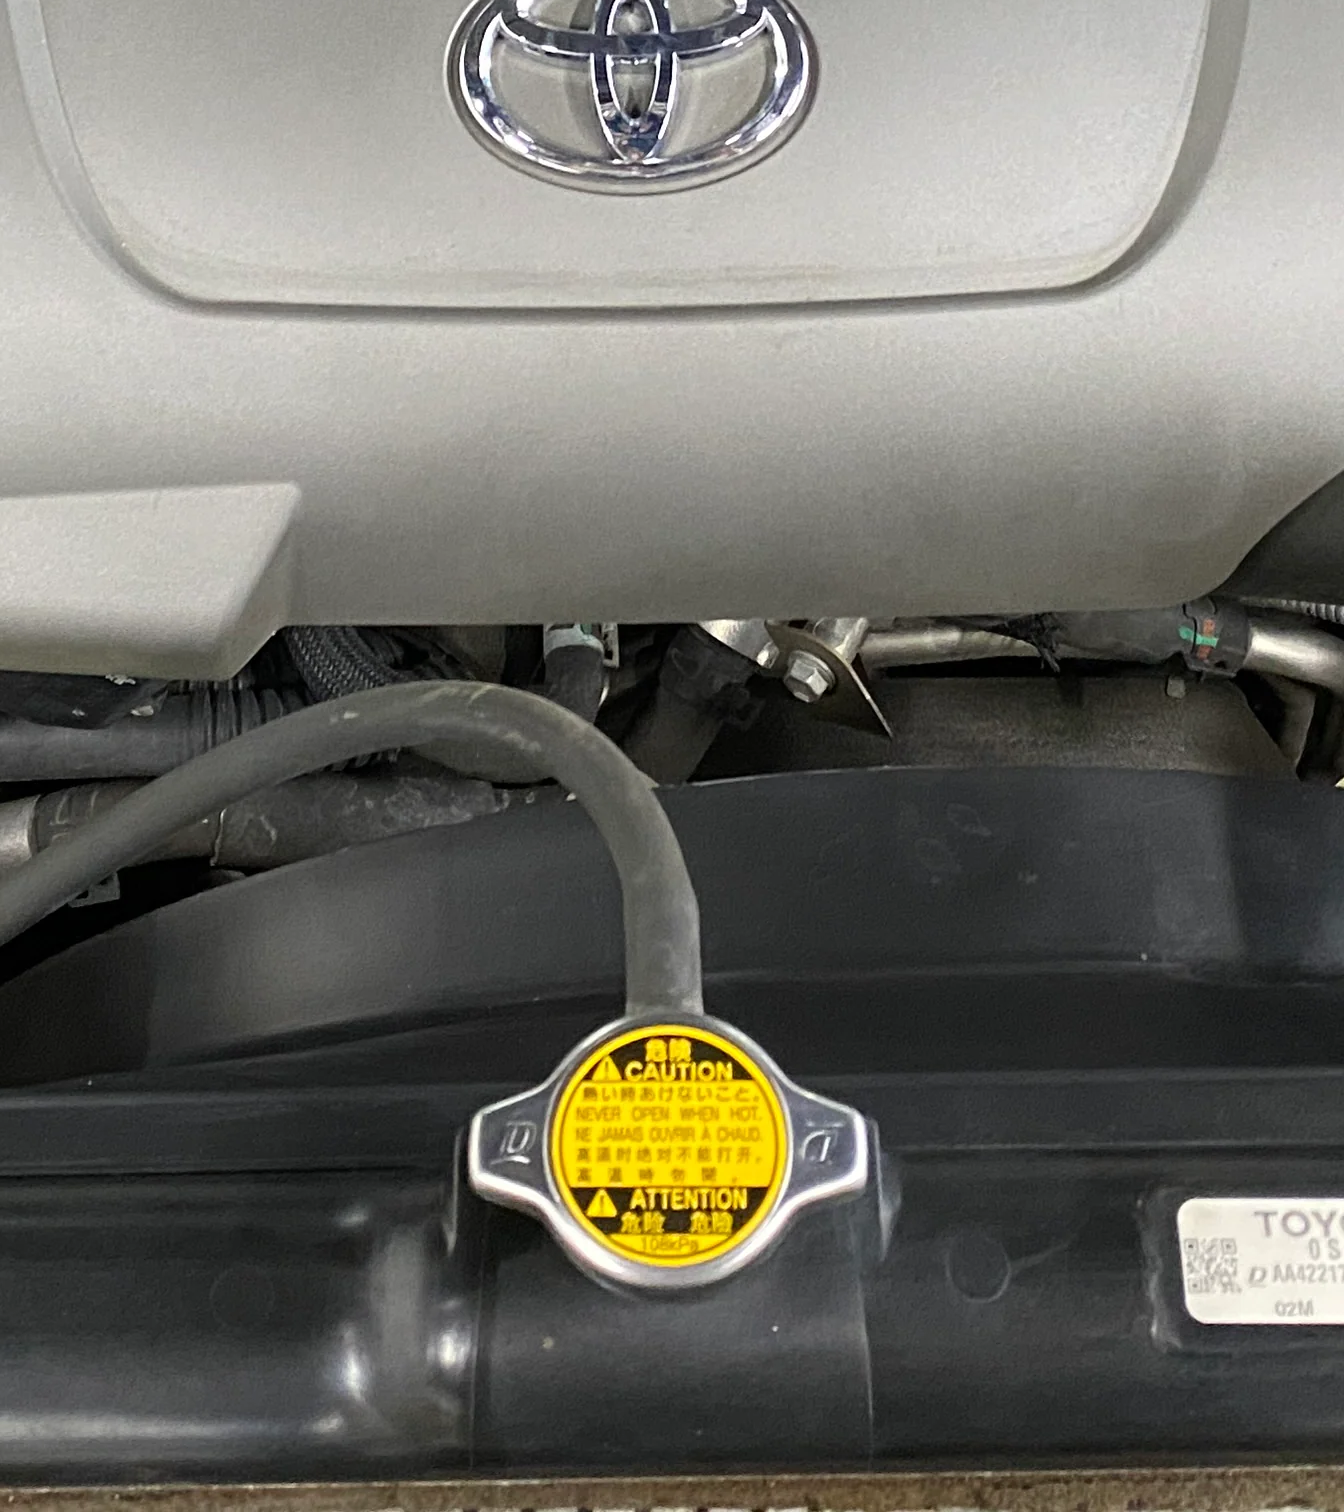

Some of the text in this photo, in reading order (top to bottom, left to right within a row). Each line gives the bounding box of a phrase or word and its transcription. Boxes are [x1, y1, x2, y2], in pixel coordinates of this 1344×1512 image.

[624, 1061, 734, 1082] CAUTION
[575, 1106, 762, 1122] NEVER OPEN WHEN HOT.
[575, 1126, 592, 1143] NE
[597, 1126, 644, 1143] JAMAIS
[629, 1188, 748, 1210] ATTENTION
